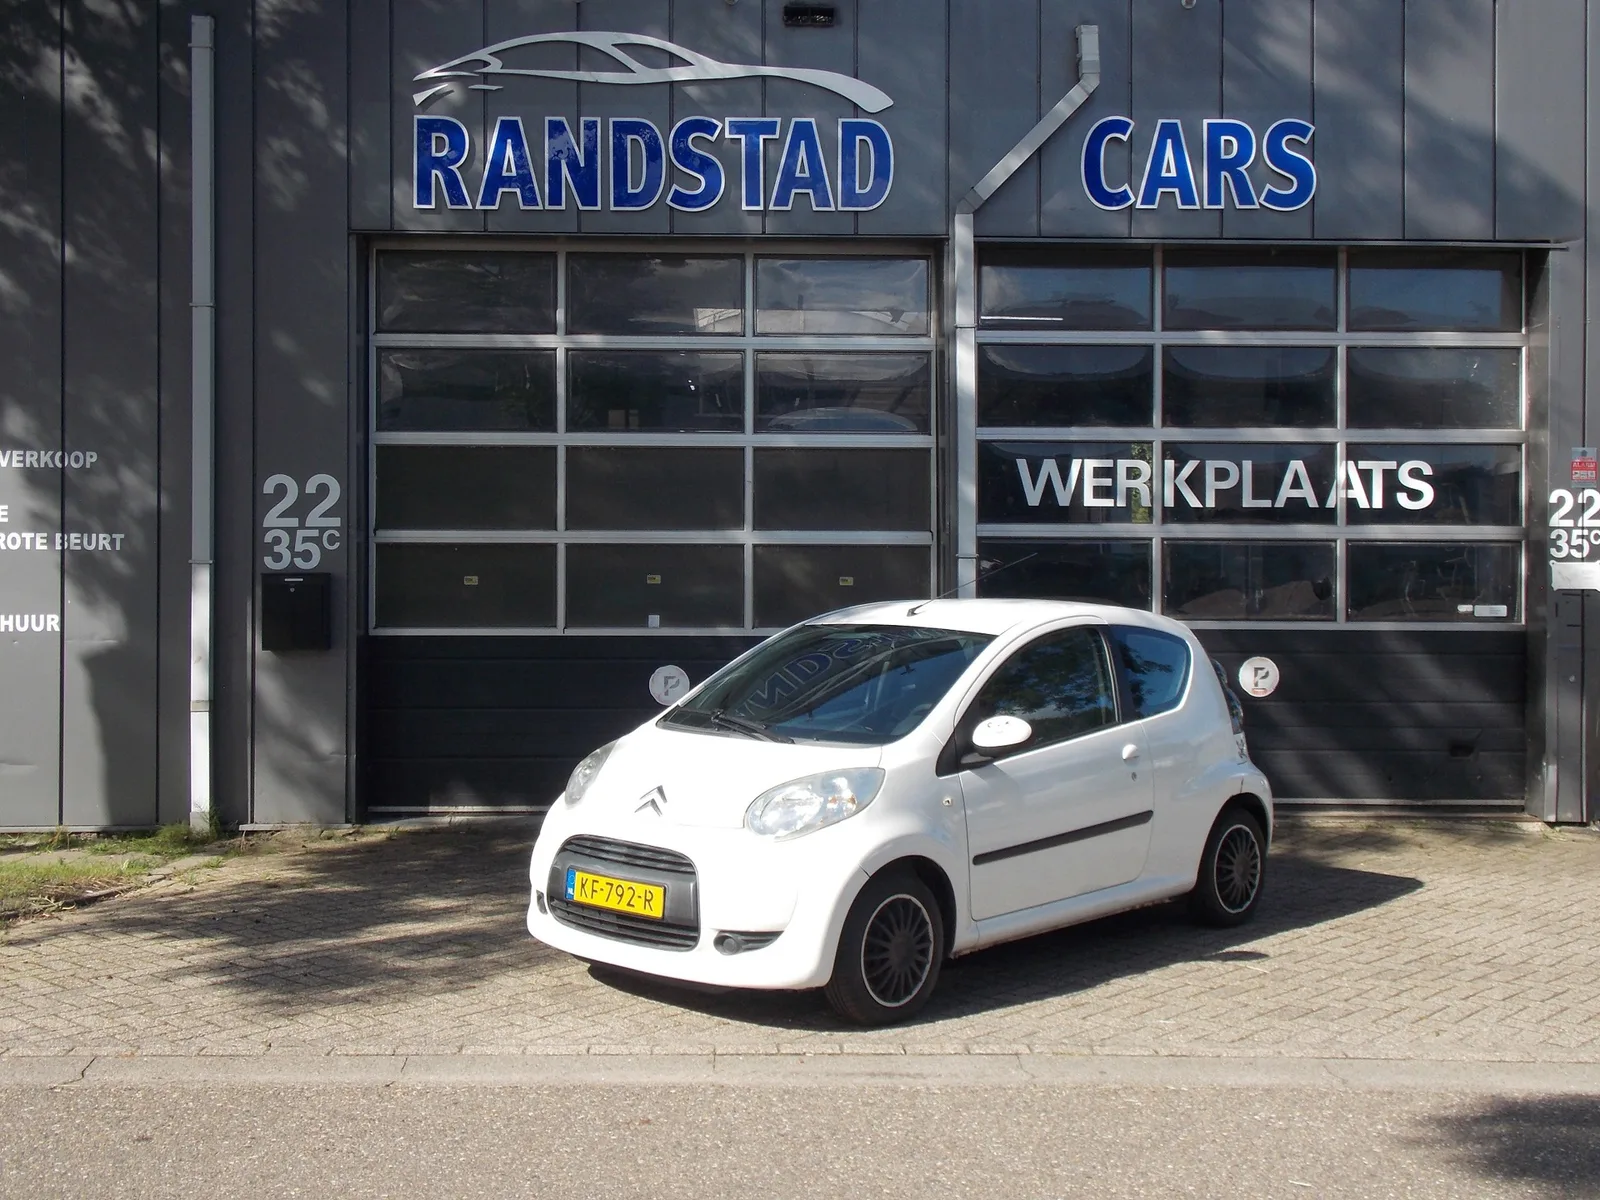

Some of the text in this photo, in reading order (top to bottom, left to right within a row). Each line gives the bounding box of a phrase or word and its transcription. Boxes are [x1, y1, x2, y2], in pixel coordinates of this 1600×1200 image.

[413, 115, 1317, 212] RANDSTAD CARS
[0, 450, 98, 469] VERKOOP
[262, 473, 341, 528] 22
[1015, 458, 1435, 511] WERKPLAATS
[1549, 488, 1600, 528] 22
[55, 533, 125, 551] BEURT
[0, 614, 60, 632] HUUR
[579, 876, 655, 912] KF-792-R
